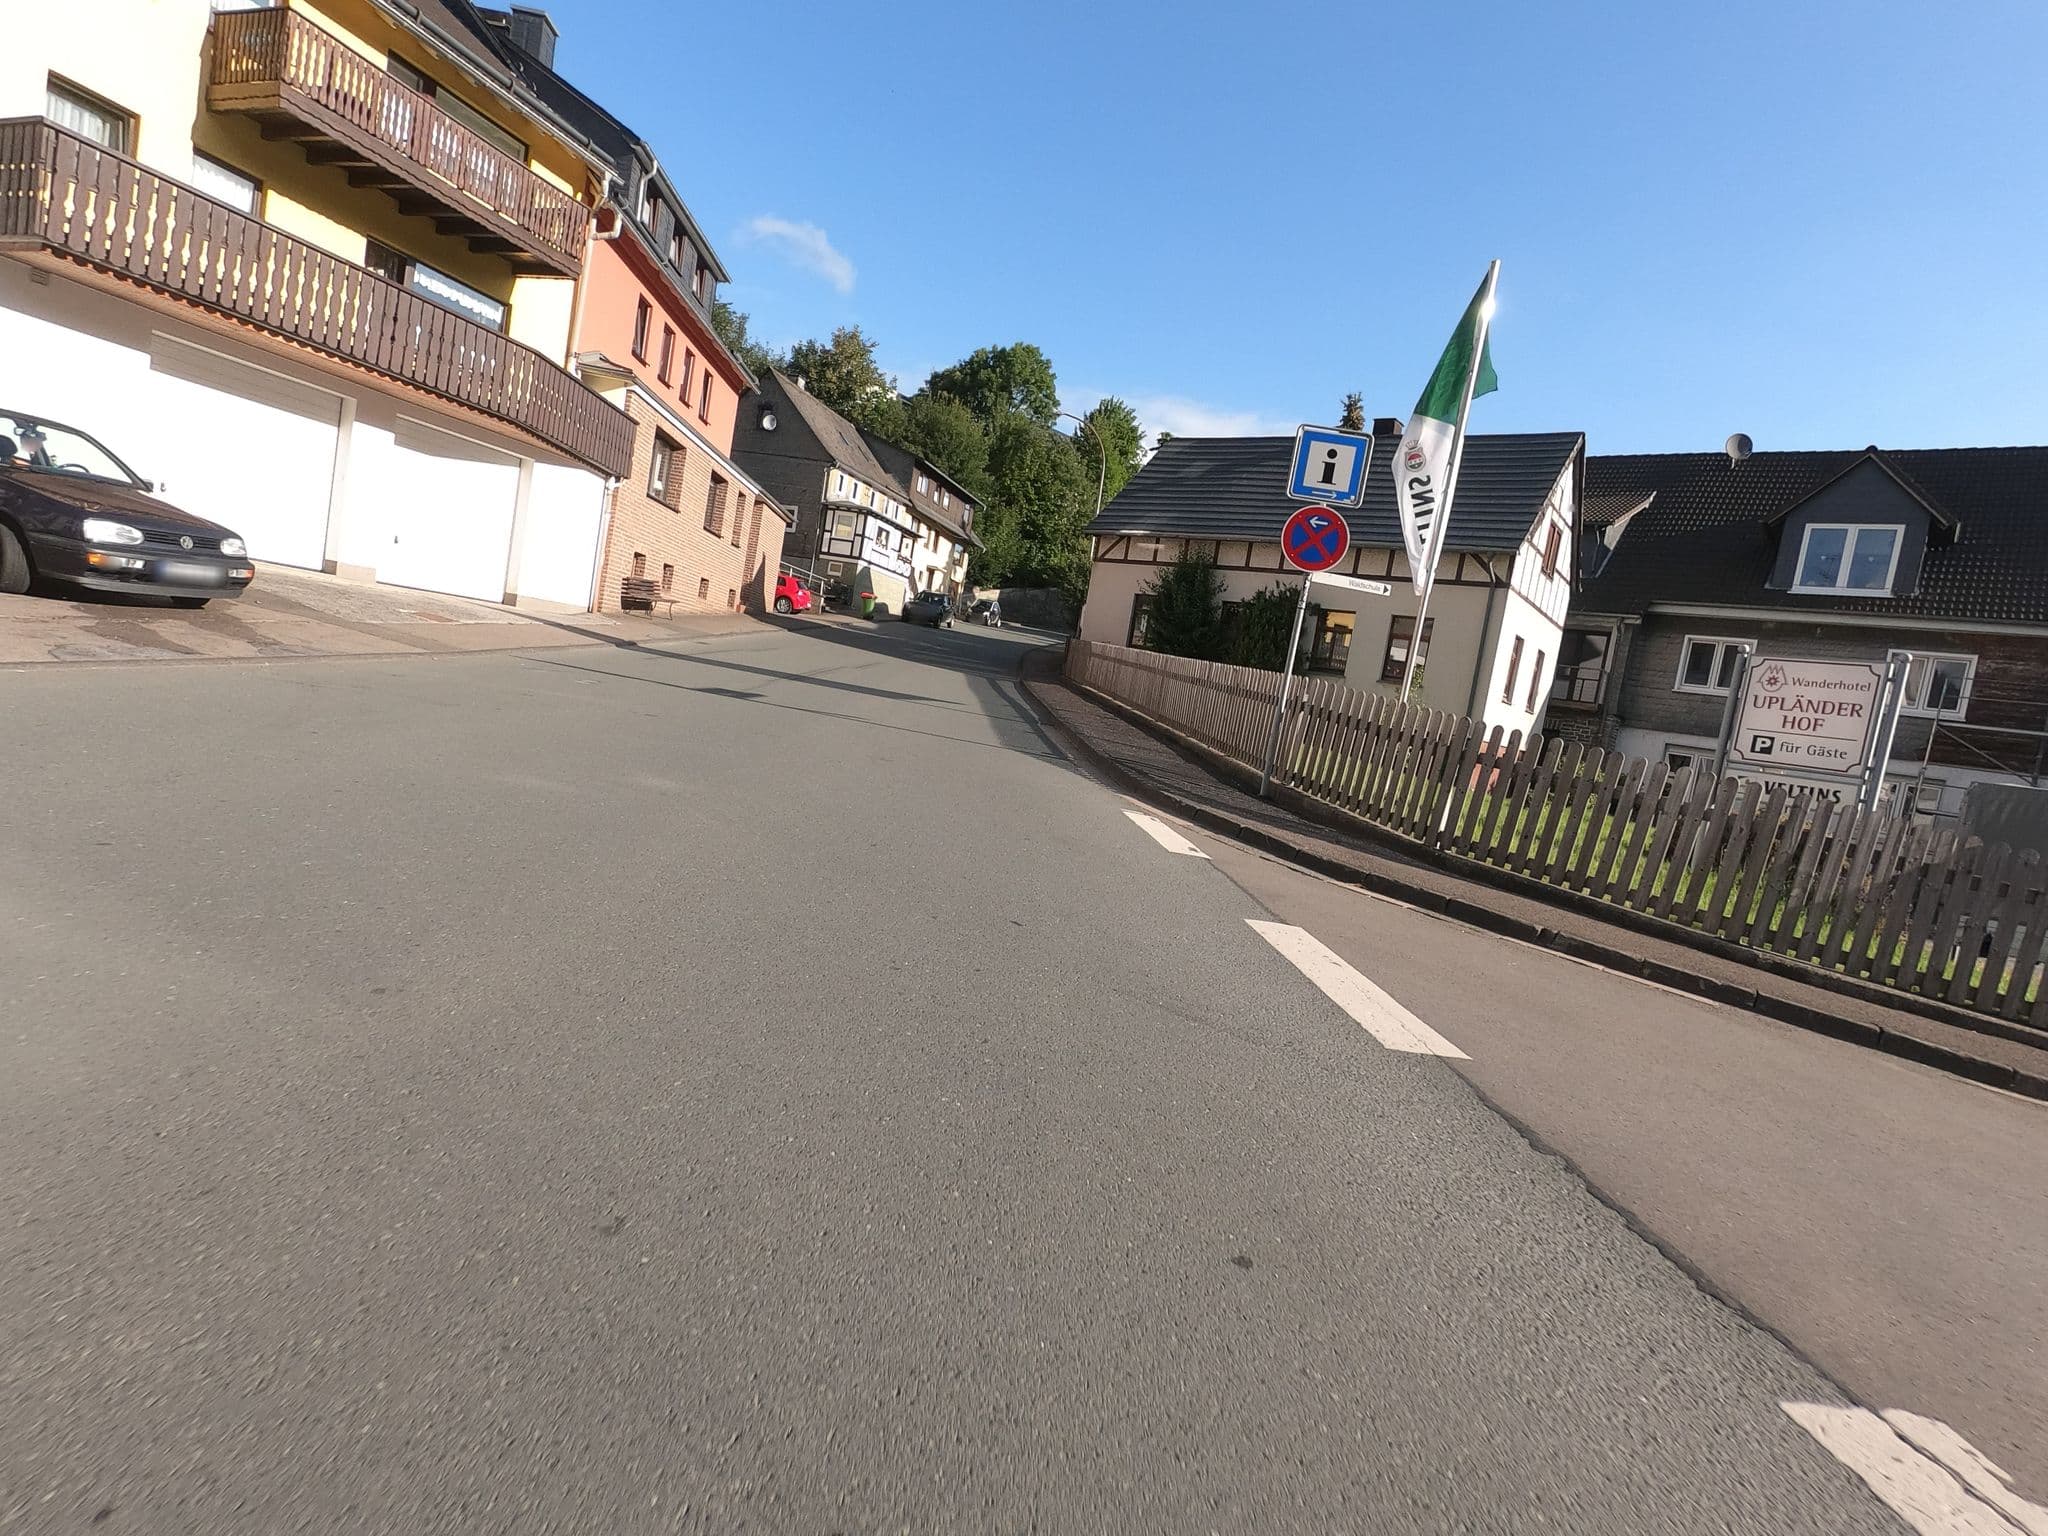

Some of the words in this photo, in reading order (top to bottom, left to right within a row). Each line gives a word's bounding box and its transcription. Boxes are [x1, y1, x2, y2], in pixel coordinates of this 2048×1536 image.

[1792, 677, 1872, 692] Wanderhotel
[1753, 694, 1863, 718] UPLÄNDER
[1781, 715, 1826, 732] HOF
[1755, 738, 1772, 752] P
[1779, 741, 1802, 754] für
[1806, 744, 1848, 760] Gäste
